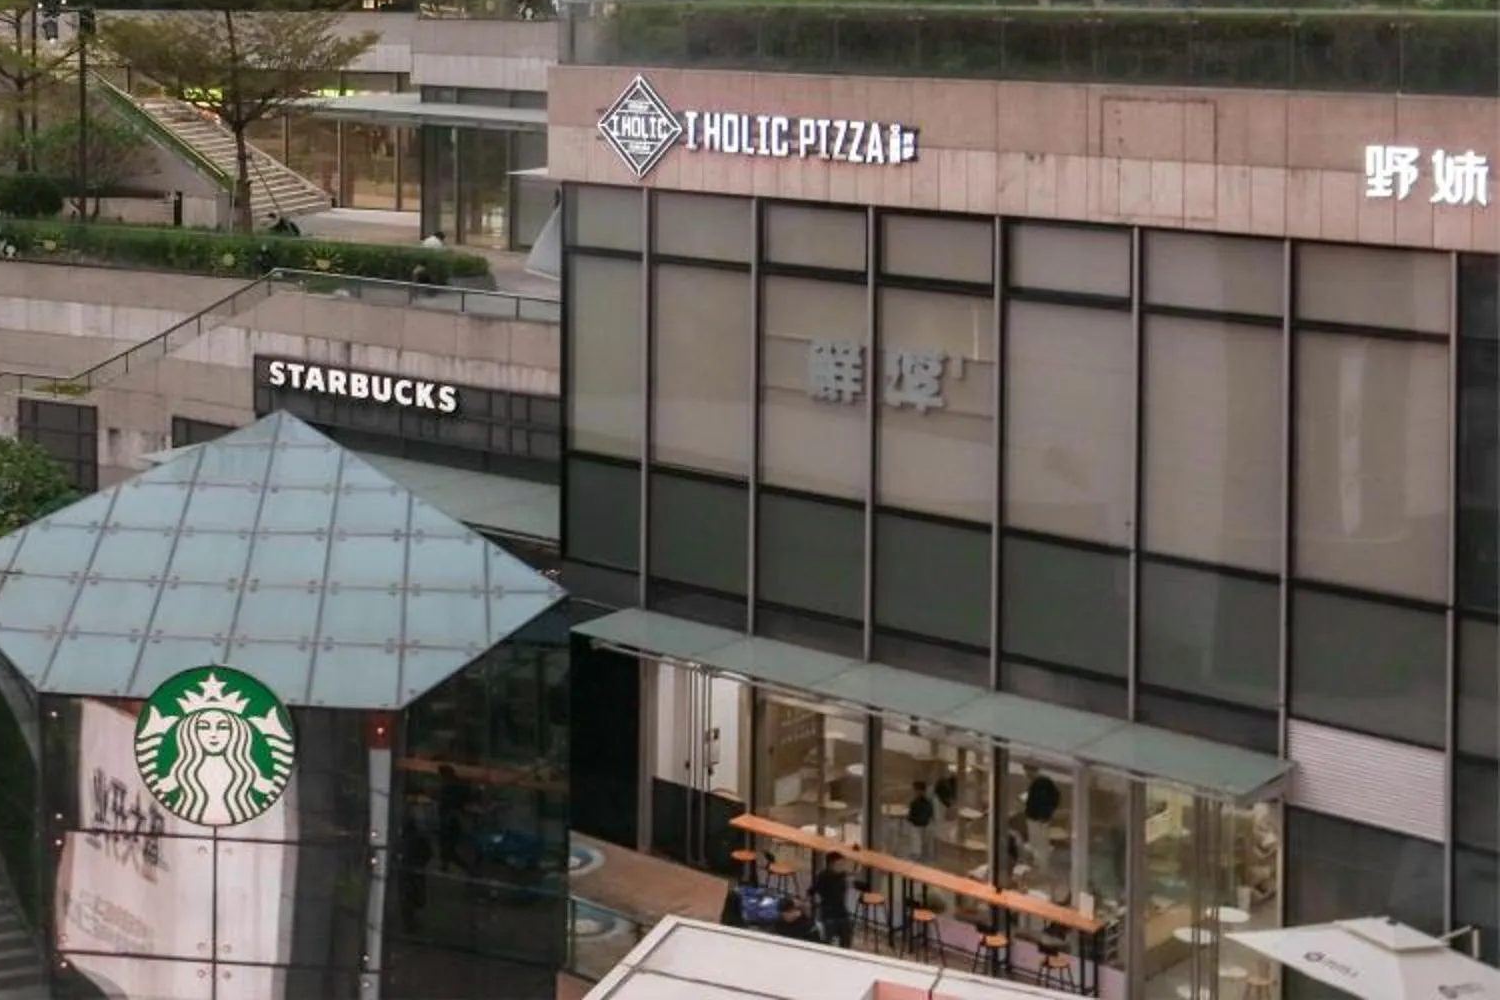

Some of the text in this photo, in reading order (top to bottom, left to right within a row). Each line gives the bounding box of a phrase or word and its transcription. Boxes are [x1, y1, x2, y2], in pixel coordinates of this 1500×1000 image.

[703, 112, 789, 156] HOLIC
[799, 117, 885, 163] PIZZA
[269, 361, 457, 413] STARBUCKS
